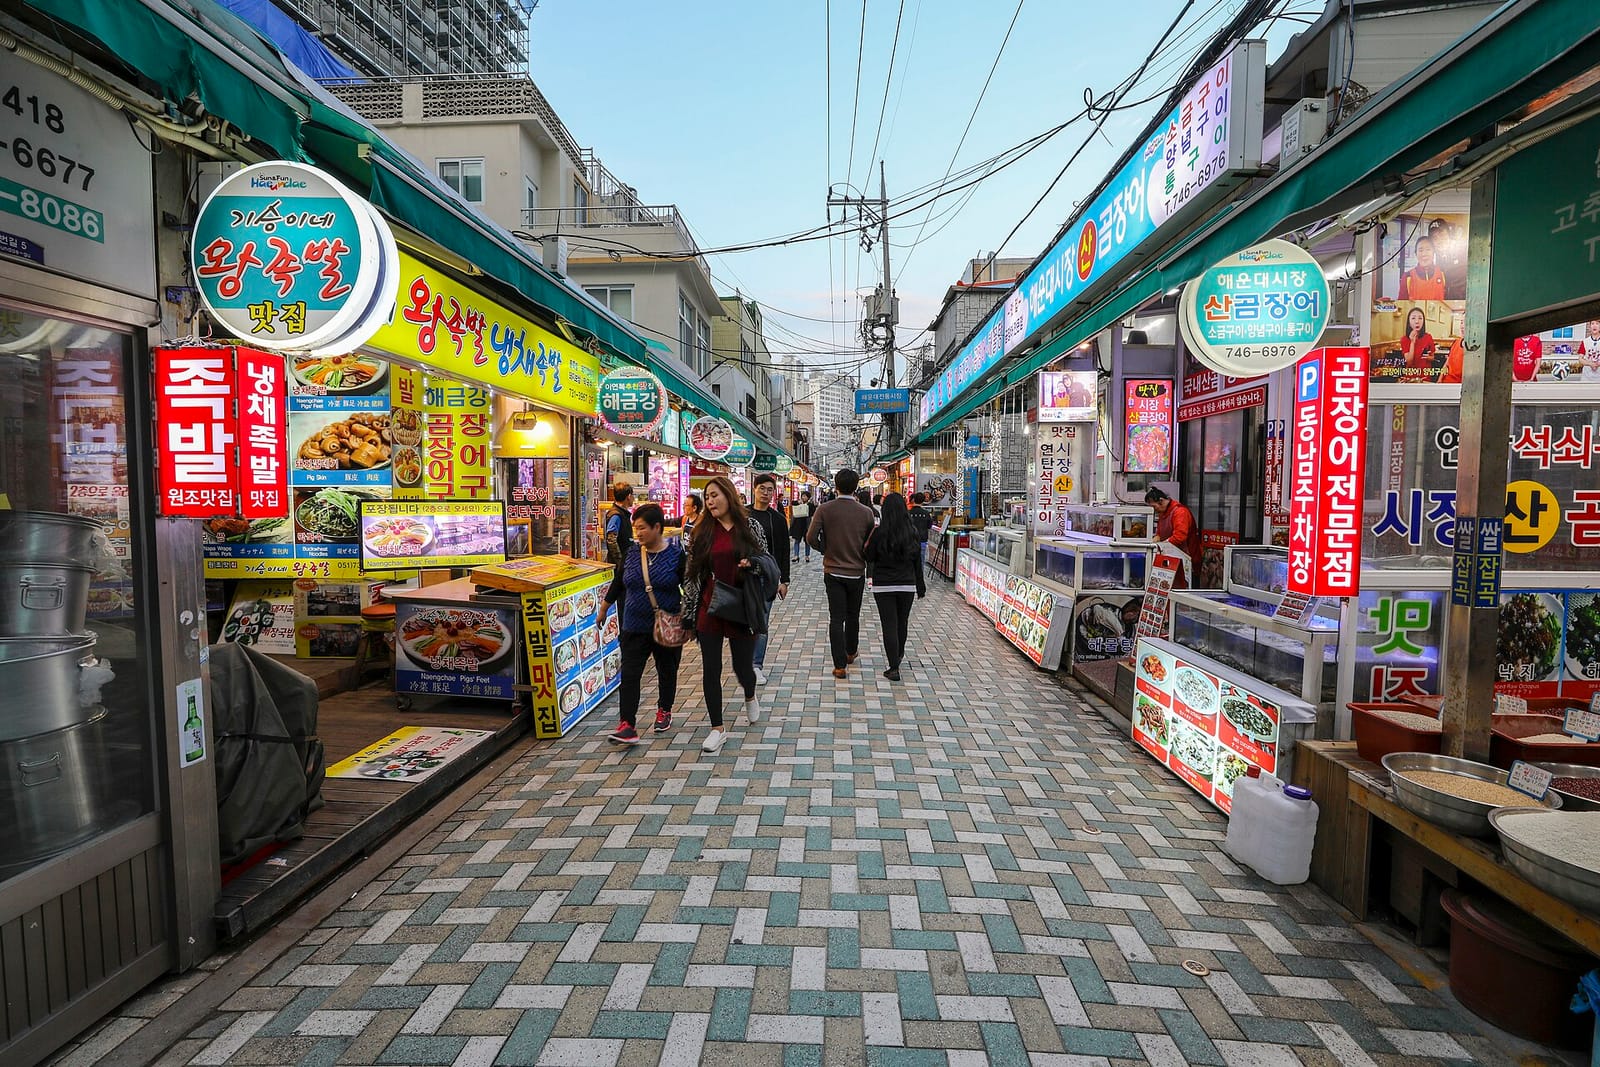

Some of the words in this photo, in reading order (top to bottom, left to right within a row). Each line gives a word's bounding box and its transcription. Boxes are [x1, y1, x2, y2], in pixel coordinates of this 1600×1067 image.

[250, 176, 307, 191] Haeundae
[1165, 150, 1226, 215] T.746-6976
[230, 200, 335, 232] 기승이네
[1080, 227, 1093, 276] 산
[1099, 183, 1145, 260] 곰장어
[21, 241, 27, 250] 5
[198, 236, 352, 300] 왕족발
[1217, 271, 1307, 290] 해운대시장
[1204, 291, 1320, 321] 산곰장어
[248, 301, 307, 334] 맛집
[402, 275, 488, 366] 왕족발
[490, 322, 563, 393] 냉채족발
[1226, 345, 1296, 358] 746-6976
[1138, 384, 1159, 396] 맛집
[1302, 366, 1318, 397] P
[425, 387, 488, 407] 해금강
[602, 393, 658, 410] 해금강
[1140, 400, 1160, 411] 시장
[165, 358, 234, 483] 족발
[247, 362, 280, 484] 냉채족발
[1129, 412, 1168, 423] 산곰장어
[1052, 426, 1076, 438] 맛집
[1268, 422, 1276, 436] P
[1321, 356, 1366, 589] 곰장어전문점
[1038, 443, 1055, 524] 연탄석쇠구이
[168, 488, 233, 507] 원조맛집
[250, 489, 279, 507] 맛집
[511, 486, 550, 501] 곰장어
[1291, 405, 1318, 584] 동남주차장
[506, 504, 556, 520] 연탄구이
[1456, 520, 1474, 551] 쌀
[1480, 521, 1501, 551] 쌀
[292, 561, 331, 577] 왕족발
[1453, 555, 1472, 606] 잡곡
[1477, 556, 1499, 605] 잡곡
[430, 655, 479, 672] 냉채족발
[1499, 663, 1536, 681] 낙지
[421, 673, 456, 682] Naengchae
